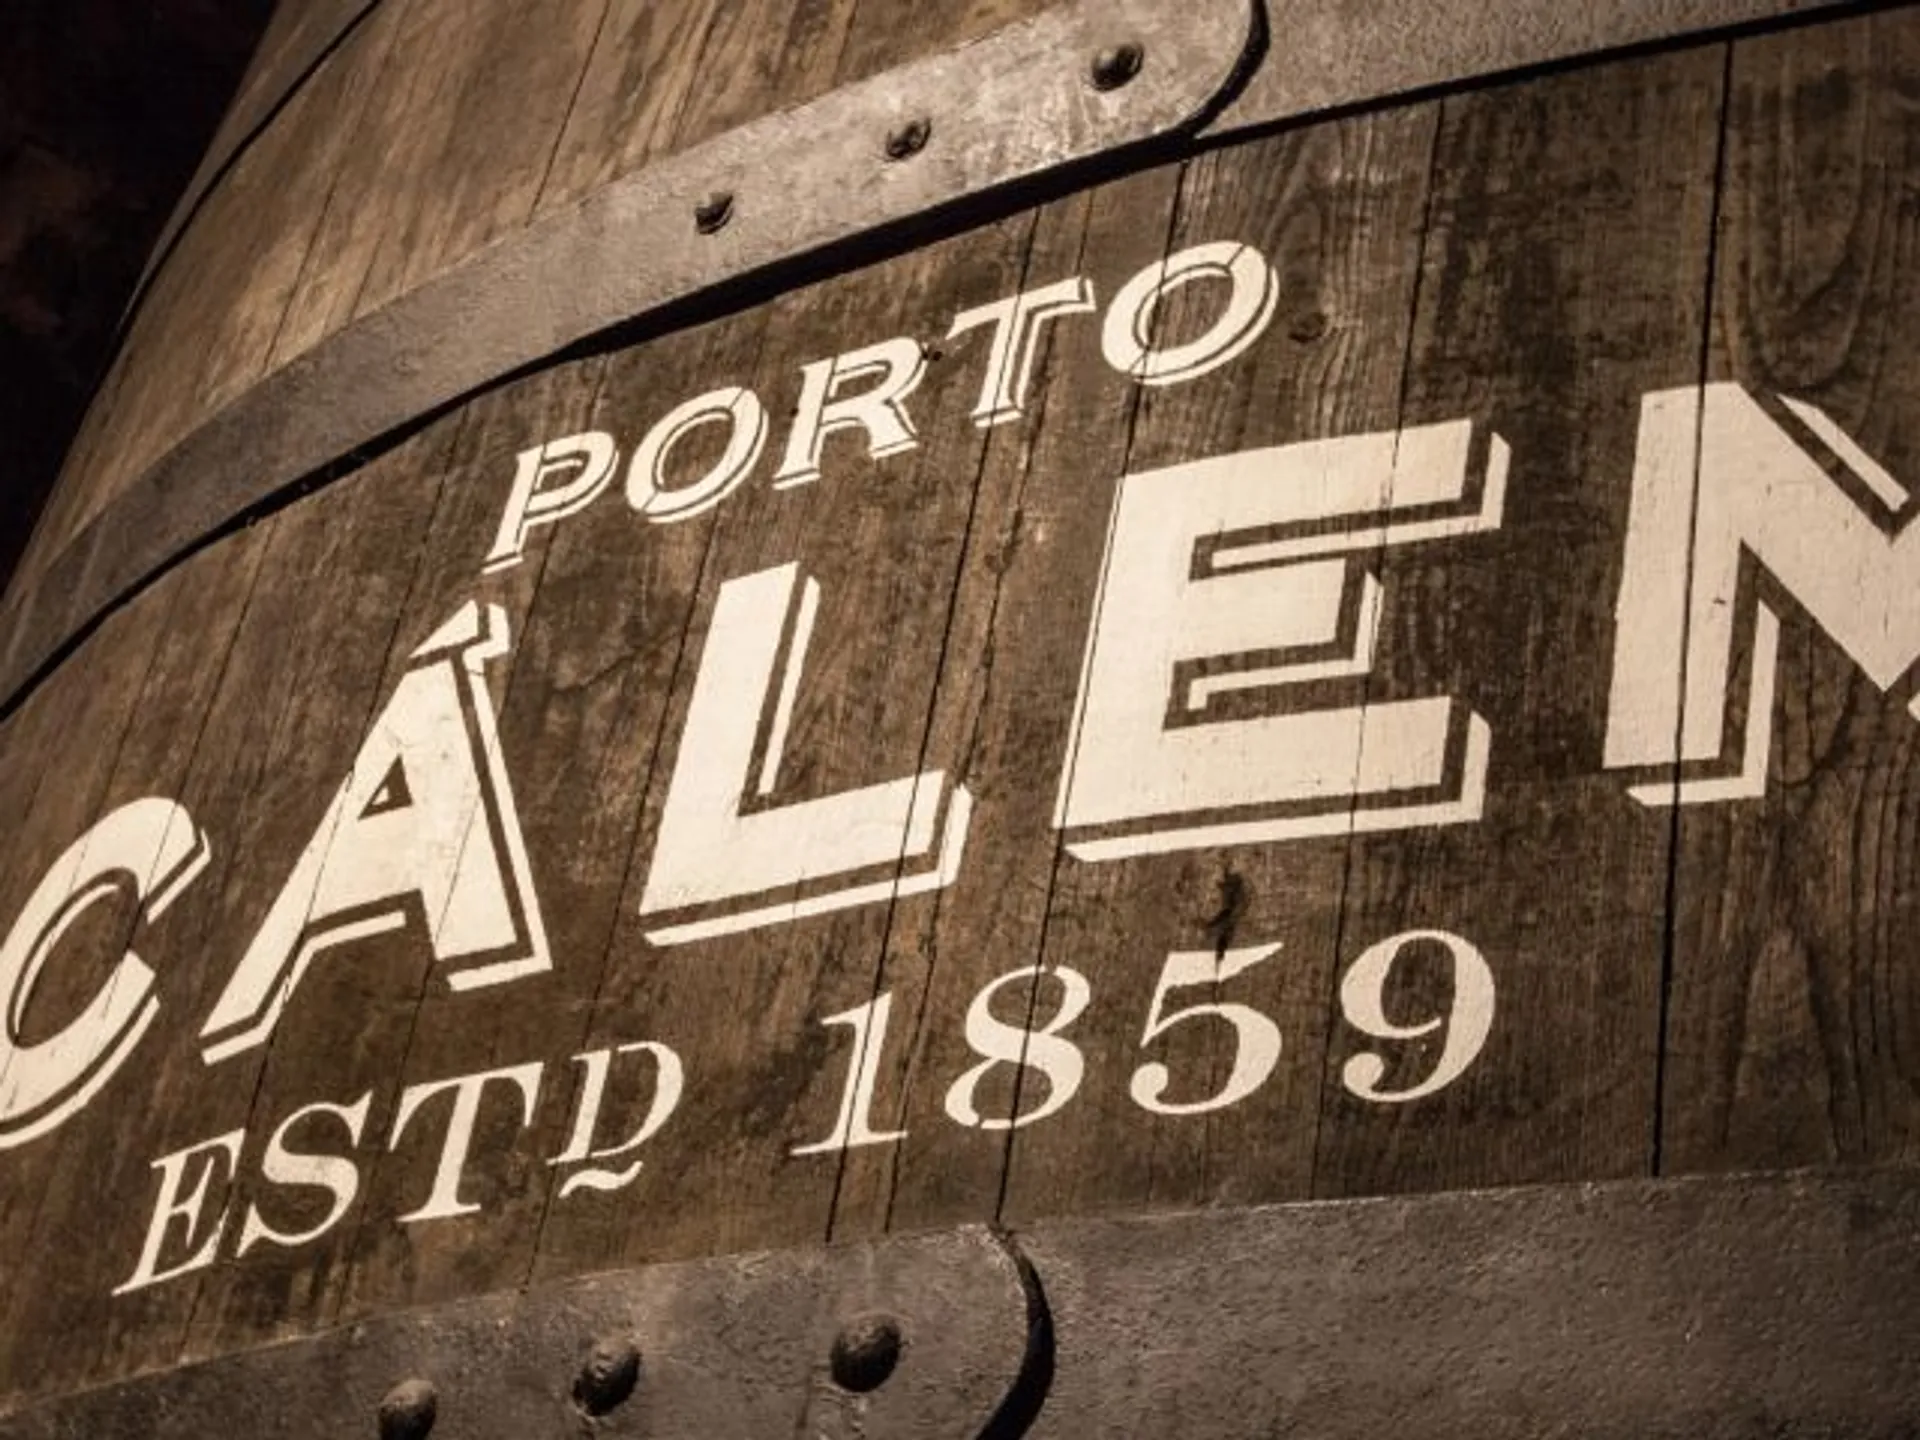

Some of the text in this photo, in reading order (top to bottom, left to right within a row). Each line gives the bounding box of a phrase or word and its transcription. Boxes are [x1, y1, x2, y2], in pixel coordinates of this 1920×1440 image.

[481, 240, 1280, 575] PORTO
[111, 929, 1496, 1296] ESTD 1859
